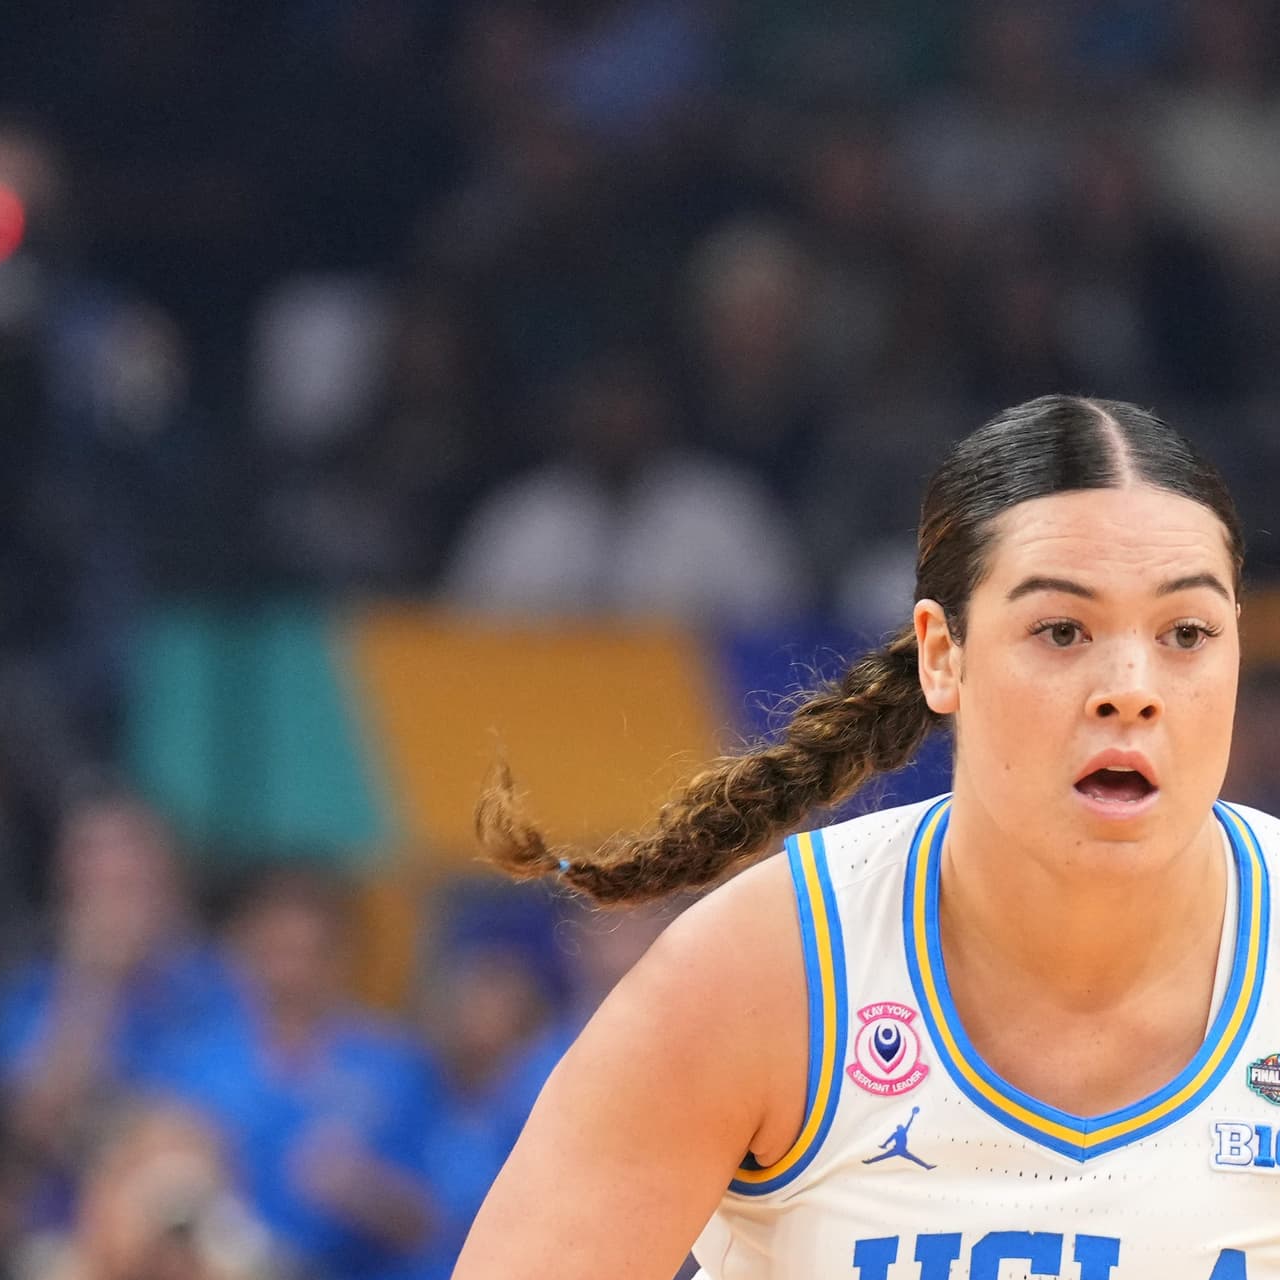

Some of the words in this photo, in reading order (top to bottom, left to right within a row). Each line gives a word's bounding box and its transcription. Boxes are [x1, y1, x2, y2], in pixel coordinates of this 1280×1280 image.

[863, 1005, 885, 1020] KAY
[886, 1005, 913, 1019] YOW
[852, 1069, 890, 1092] SERVANT
[892, 1070, 923, 1092] LEADER
[1251, 1067, 1280, 1084] FINAL
